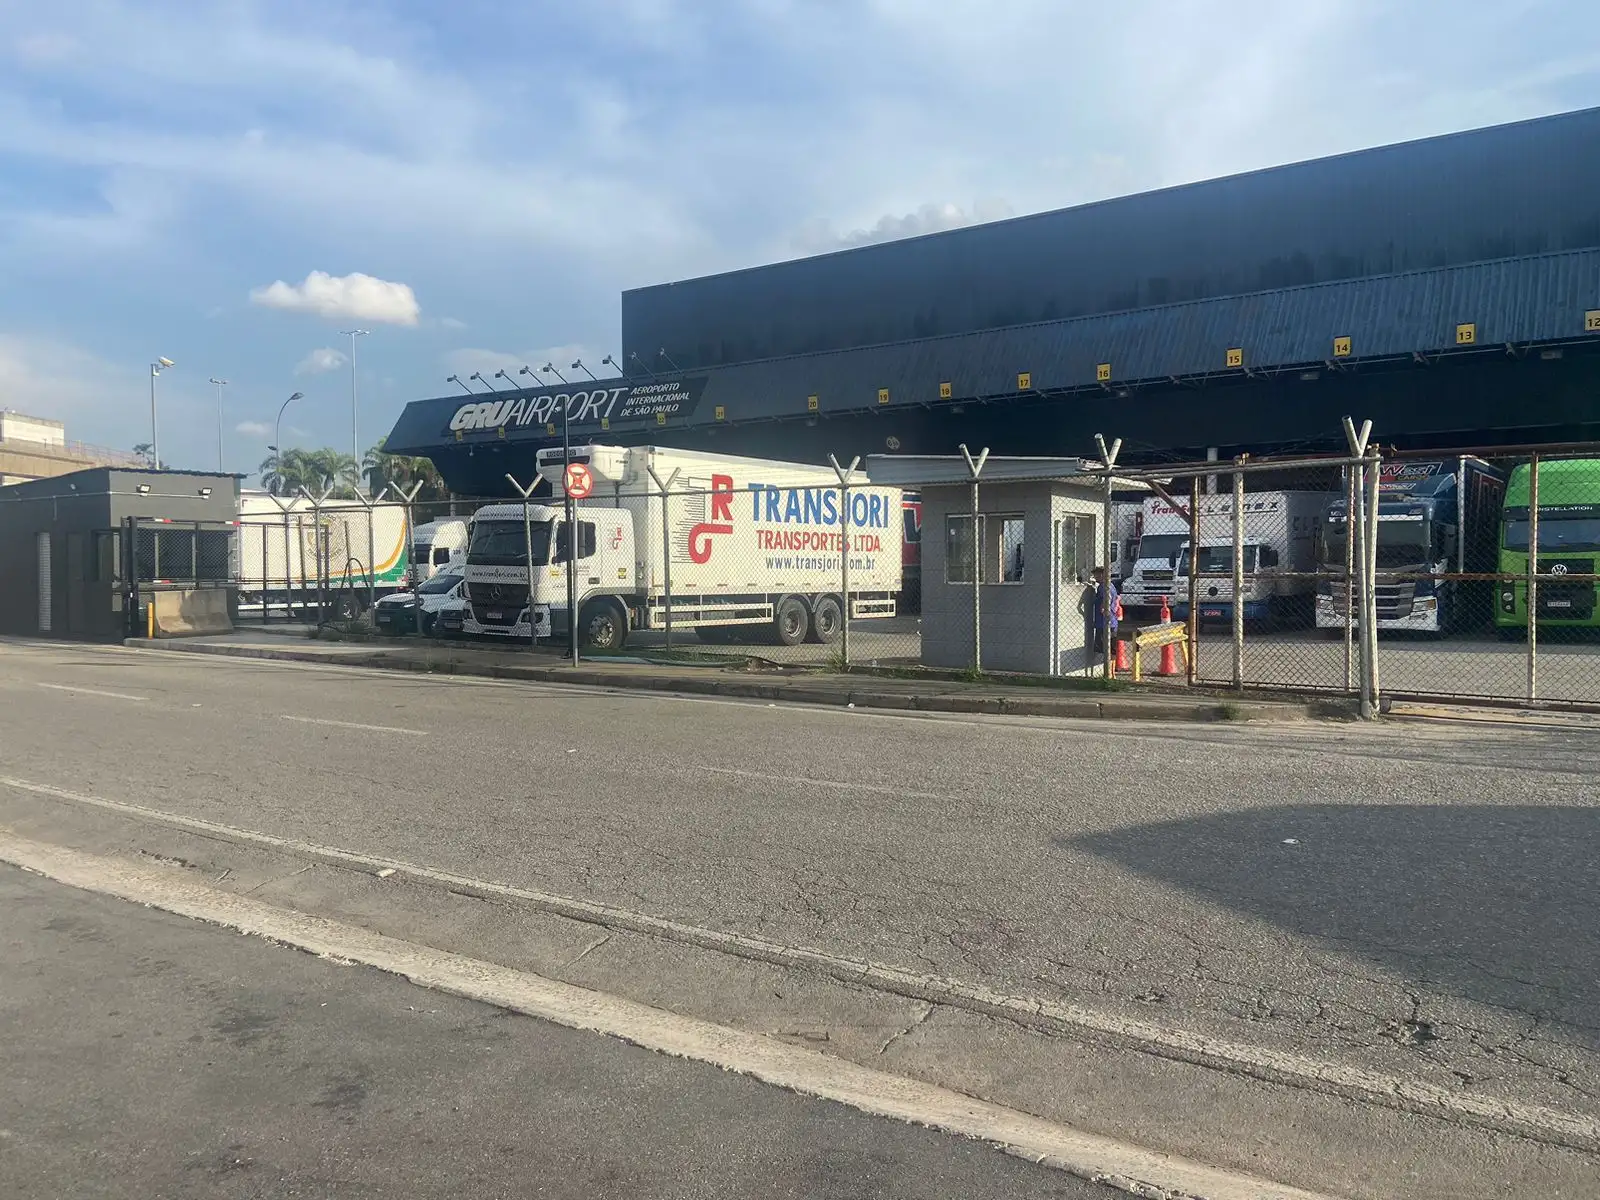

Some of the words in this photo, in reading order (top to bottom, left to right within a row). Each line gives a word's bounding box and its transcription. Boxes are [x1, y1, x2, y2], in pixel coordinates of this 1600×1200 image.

[1587, 317, 1600, 328] 12
[1458, 331, 1472, 341] 13
[1335, 343, 1348, 352] 14
[1229, 355, 1240, 364] 15
[1099, 369, 1109, 378] 16
[630, 382, 680, 395] AEROPORTO
[1020, 379, 1029, 387] 17
[625, 391, 690, 406] INTERNACIONAL
[620, 407, 633, 417] DE
[633, 405, 651, 416] SÃO
[651, 403, 680, 414] PAULO
[748, 483, 889, 528] TRANSJORI
[765, 555, 876, 572] www.transjori.om.br
